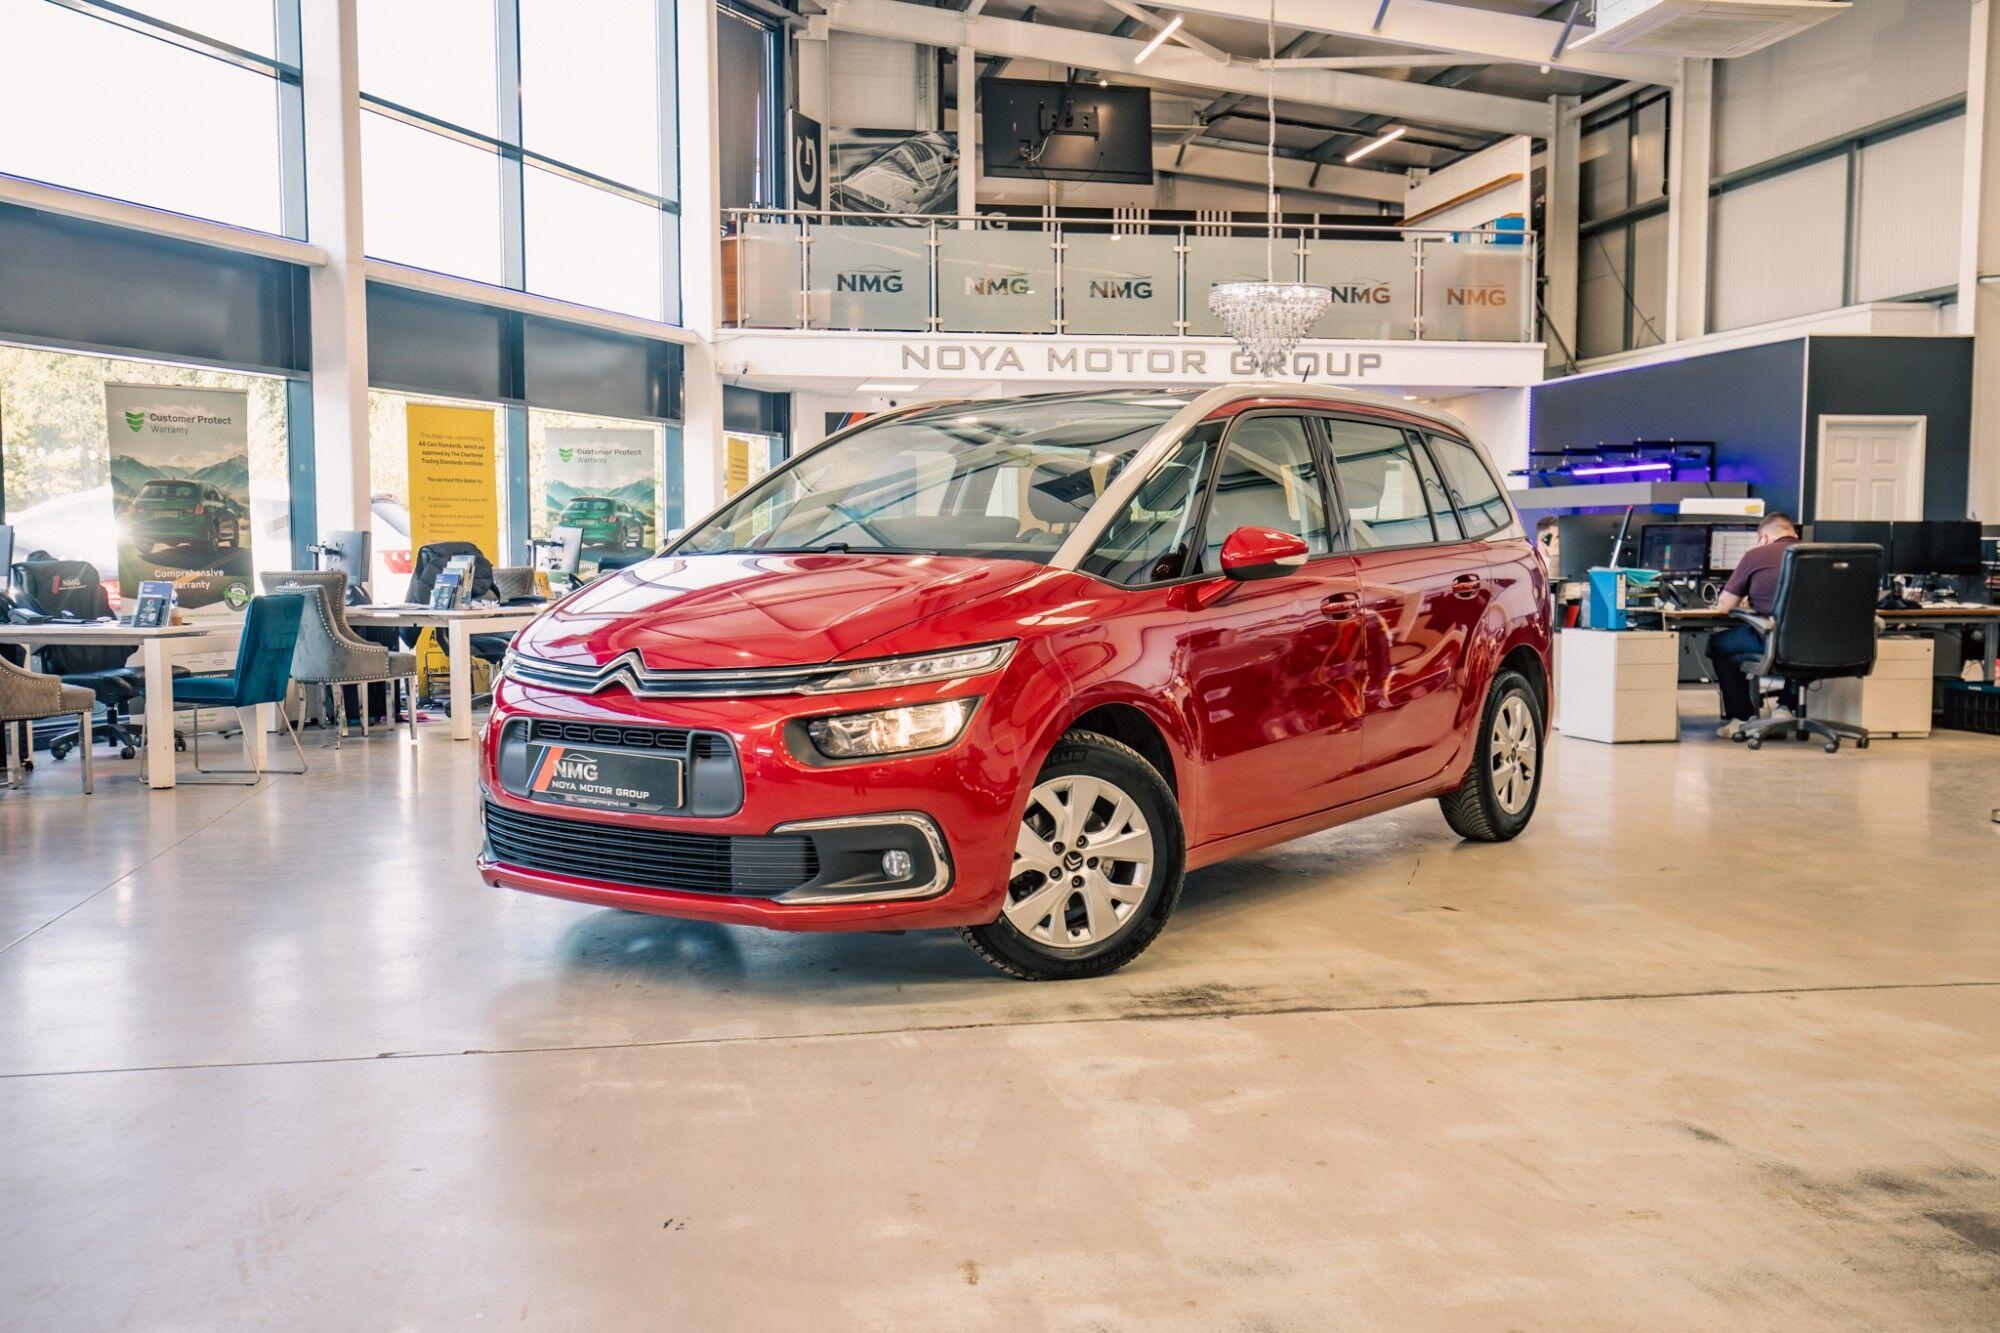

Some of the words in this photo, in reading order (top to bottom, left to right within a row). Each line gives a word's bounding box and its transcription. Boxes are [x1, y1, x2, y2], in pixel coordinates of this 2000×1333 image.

[836, 274, 903, 292] NMG
[964, 277, 1030, 295] NMG
[1089, 280, 1152, 299] NMG
[1331, 286, 1391, 304] NMG
[1447, 288, 1506, 306] NMG
[902, 345, 1024, 372] NOYA
[1048, 348, 1207, 375] MOTOR
[150, 414, 195, 423] Customer
[198, 416, 232, 425] Protect
[151, 426, 188, 434] Warranty
[154, 569, 224, 578] Comprehensive
[553, 760, 598, 780] NMG
[552, 780, 576, 790] NOYA
[580, 784, 612, 794] MOTOR
[616, 788, 649, 799] GROUP
